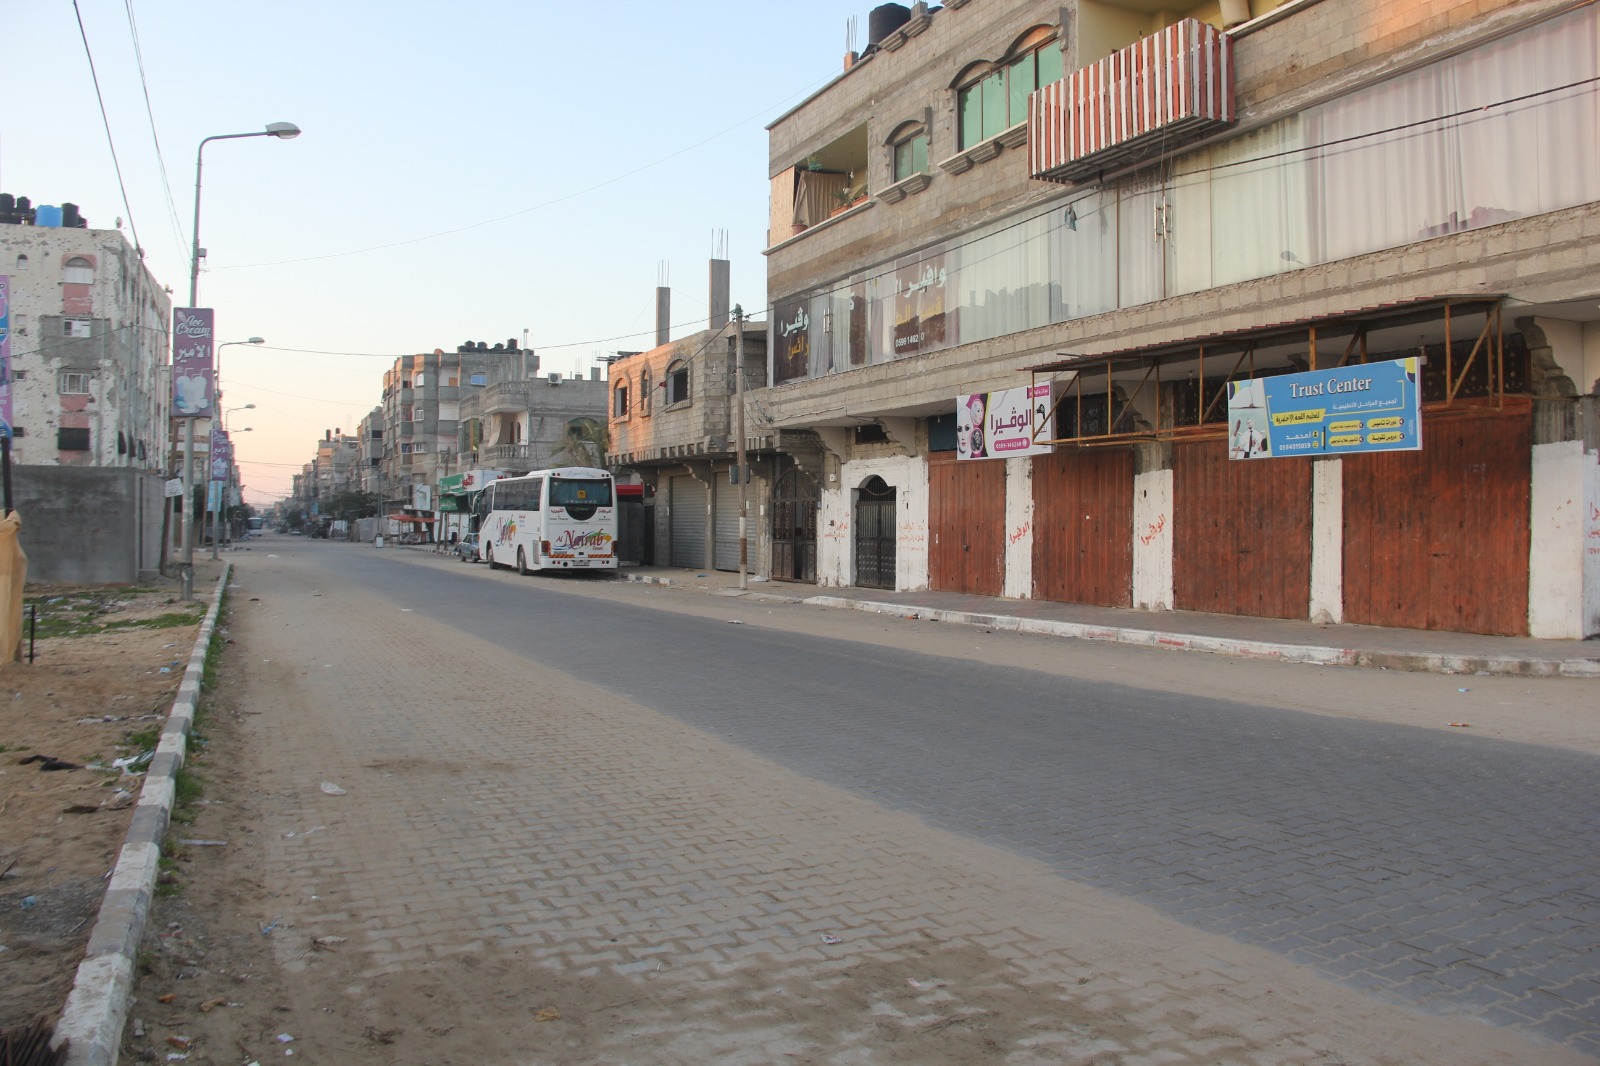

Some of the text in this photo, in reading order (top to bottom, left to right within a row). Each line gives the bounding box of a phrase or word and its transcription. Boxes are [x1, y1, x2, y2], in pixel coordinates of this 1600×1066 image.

[187, 314, 204, 326] Ice
[176, 322, 211, 338] Cream
[1290, 377, 1372, 398] Trust Center
[563, 528, 604, 549] Nairab
